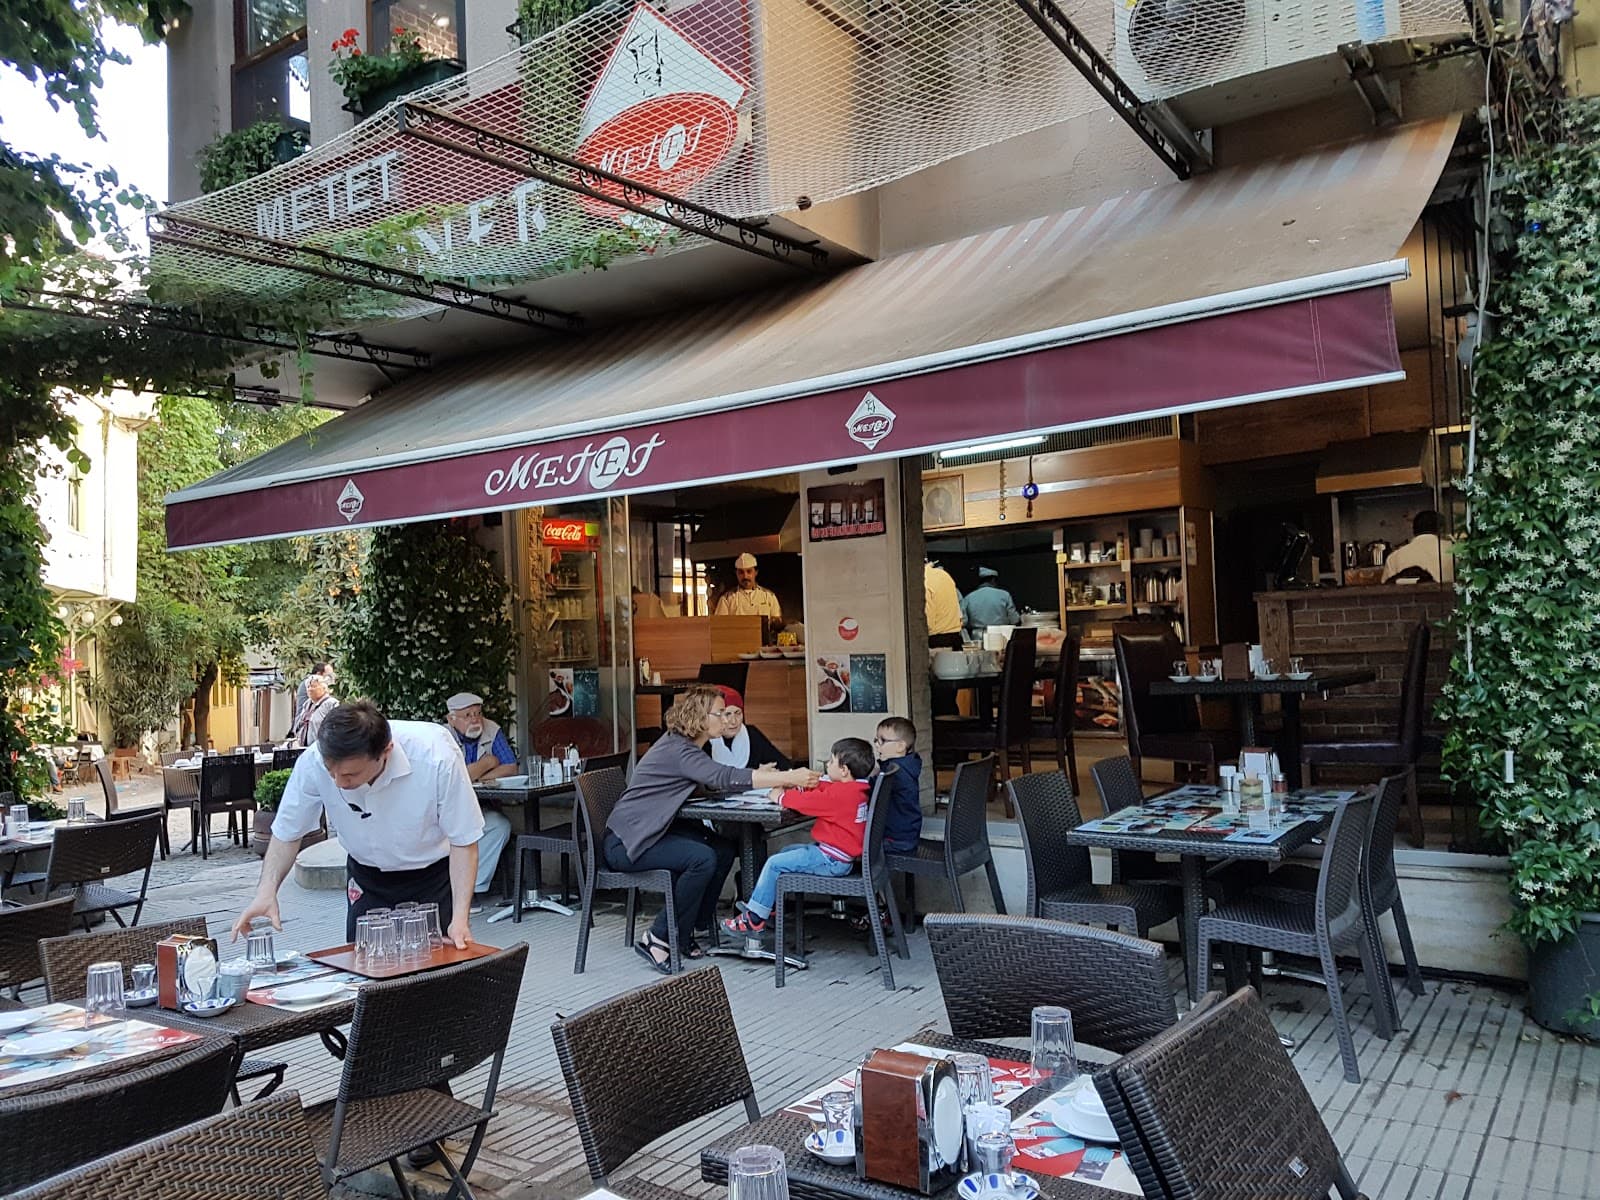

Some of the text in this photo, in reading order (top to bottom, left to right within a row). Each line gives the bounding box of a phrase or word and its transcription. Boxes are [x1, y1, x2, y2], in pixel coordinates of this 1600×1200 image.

[582, 117, 711, 185] METET
[256, 151, 397, 239] METET
[484, 432, 666, 496] METET
[543, 523, 583, 541] Coca-Cola
